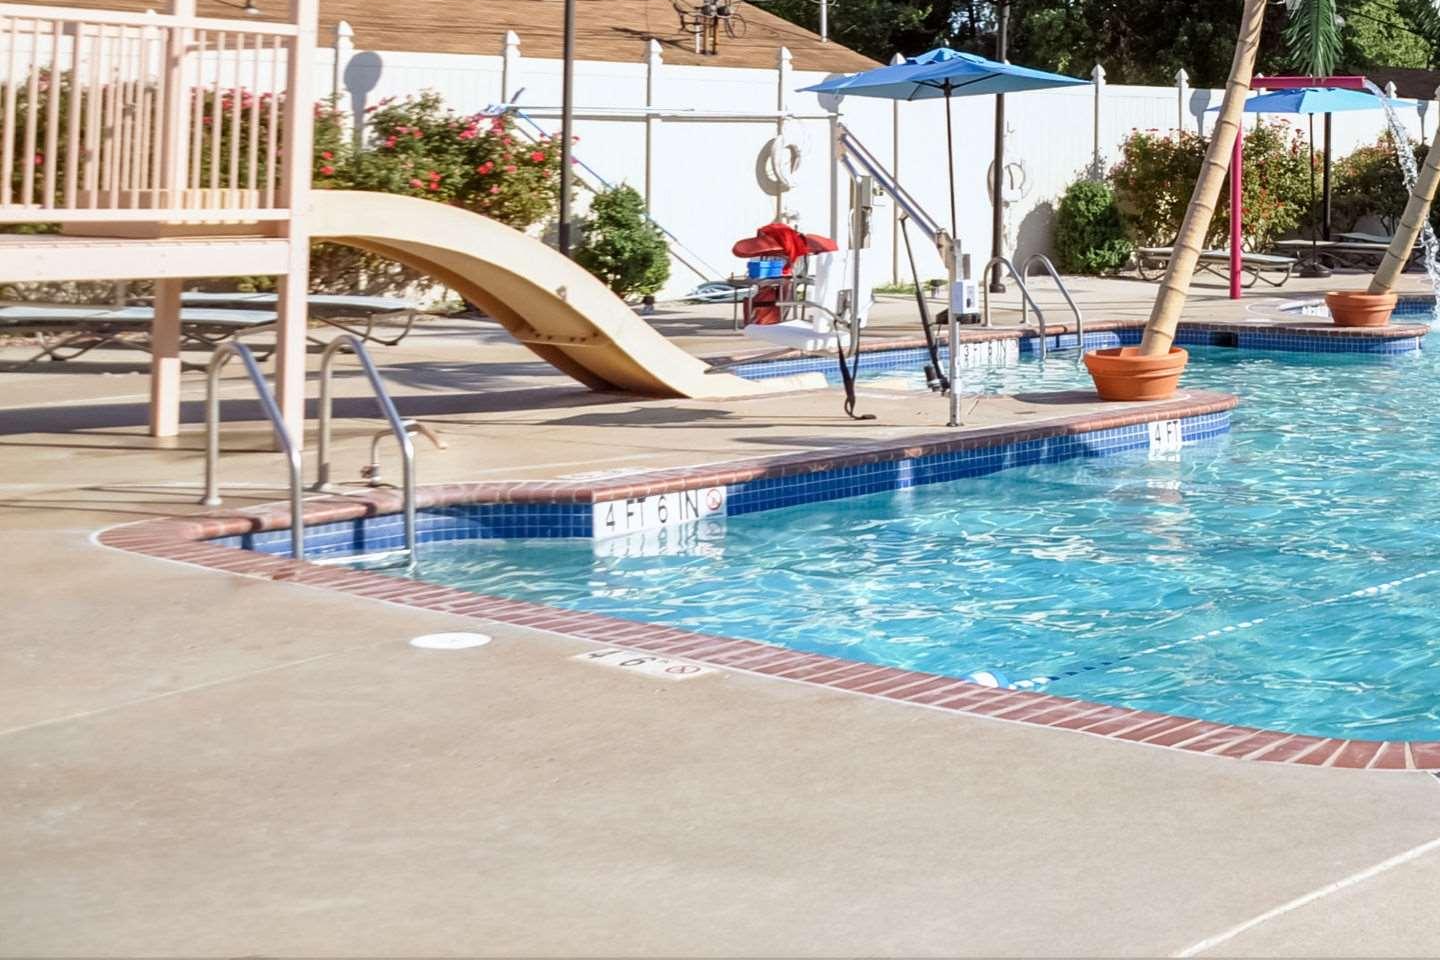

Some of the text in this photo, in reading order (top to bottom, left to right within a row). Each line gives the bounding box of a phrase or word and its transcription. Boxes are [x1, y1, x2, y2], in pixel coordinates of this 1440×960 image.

[1166, 420, 1179, 446] FT
[605, 489, 700, 532] 4 FT 6 IN
